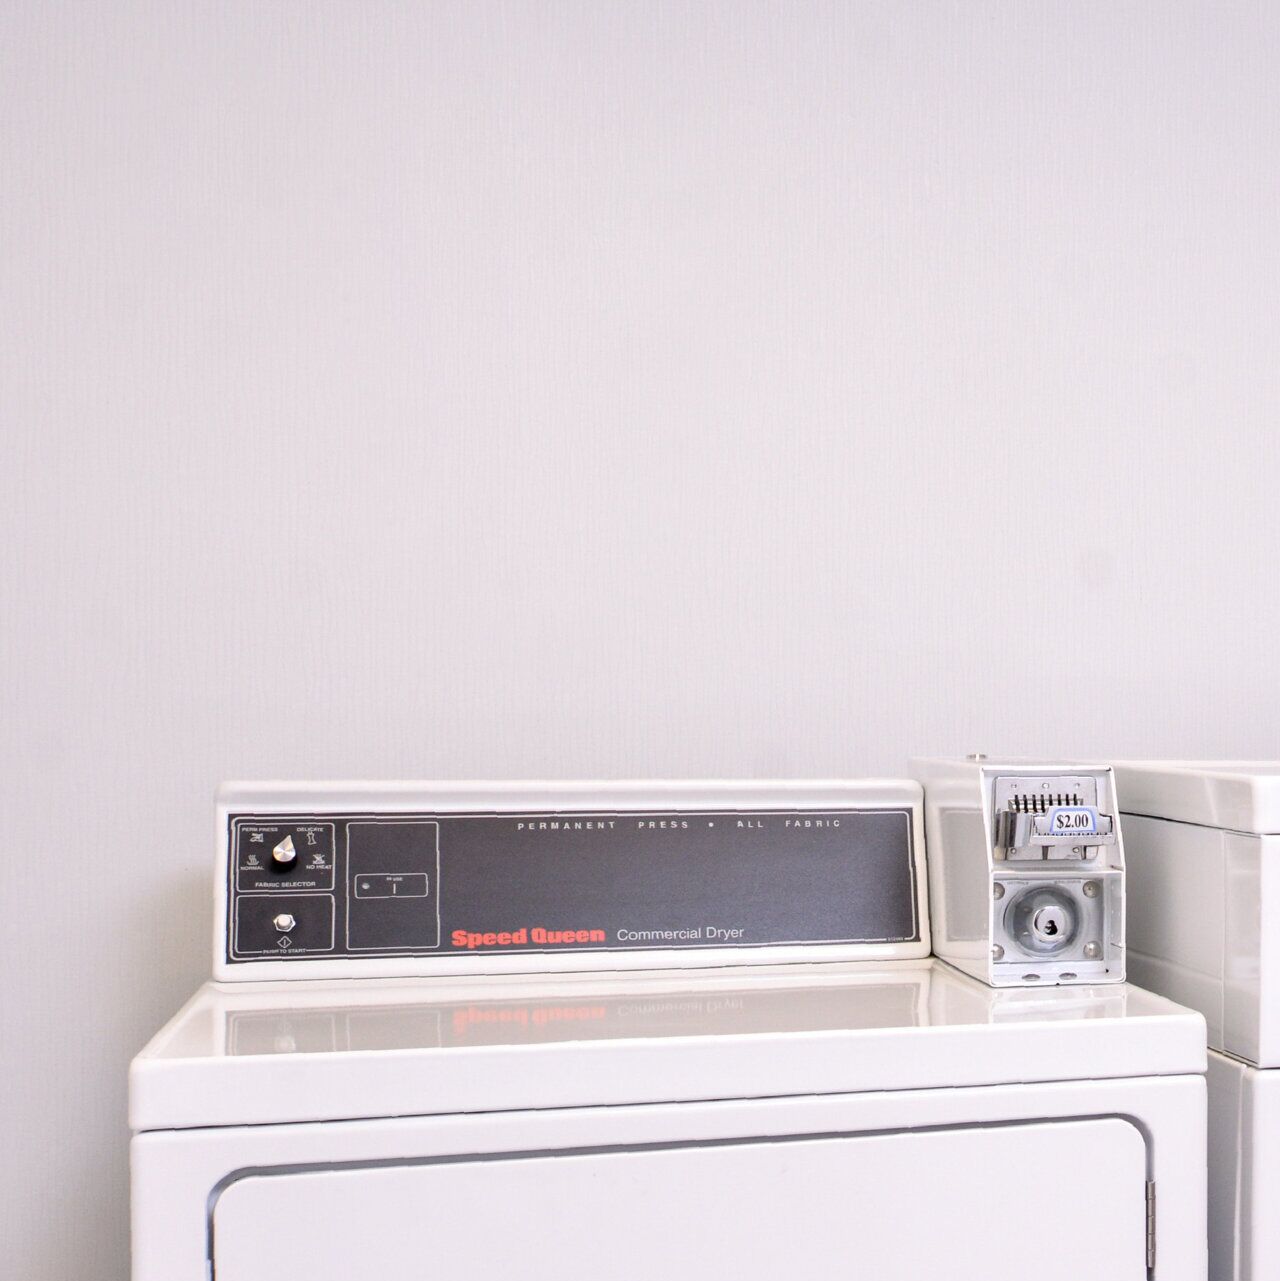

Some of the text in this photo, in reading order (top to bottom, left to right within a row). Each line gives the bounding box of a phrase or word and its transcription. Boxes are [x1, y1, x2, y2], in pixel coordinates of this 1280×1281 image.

[518, 821, 616, 830] PERMANENT
[638, 821, 688, 829] PRESS
[1056, 814, 1088, 829] $2.00
[452, 926, 744, 948] Speed Queen Commercial Dryer
